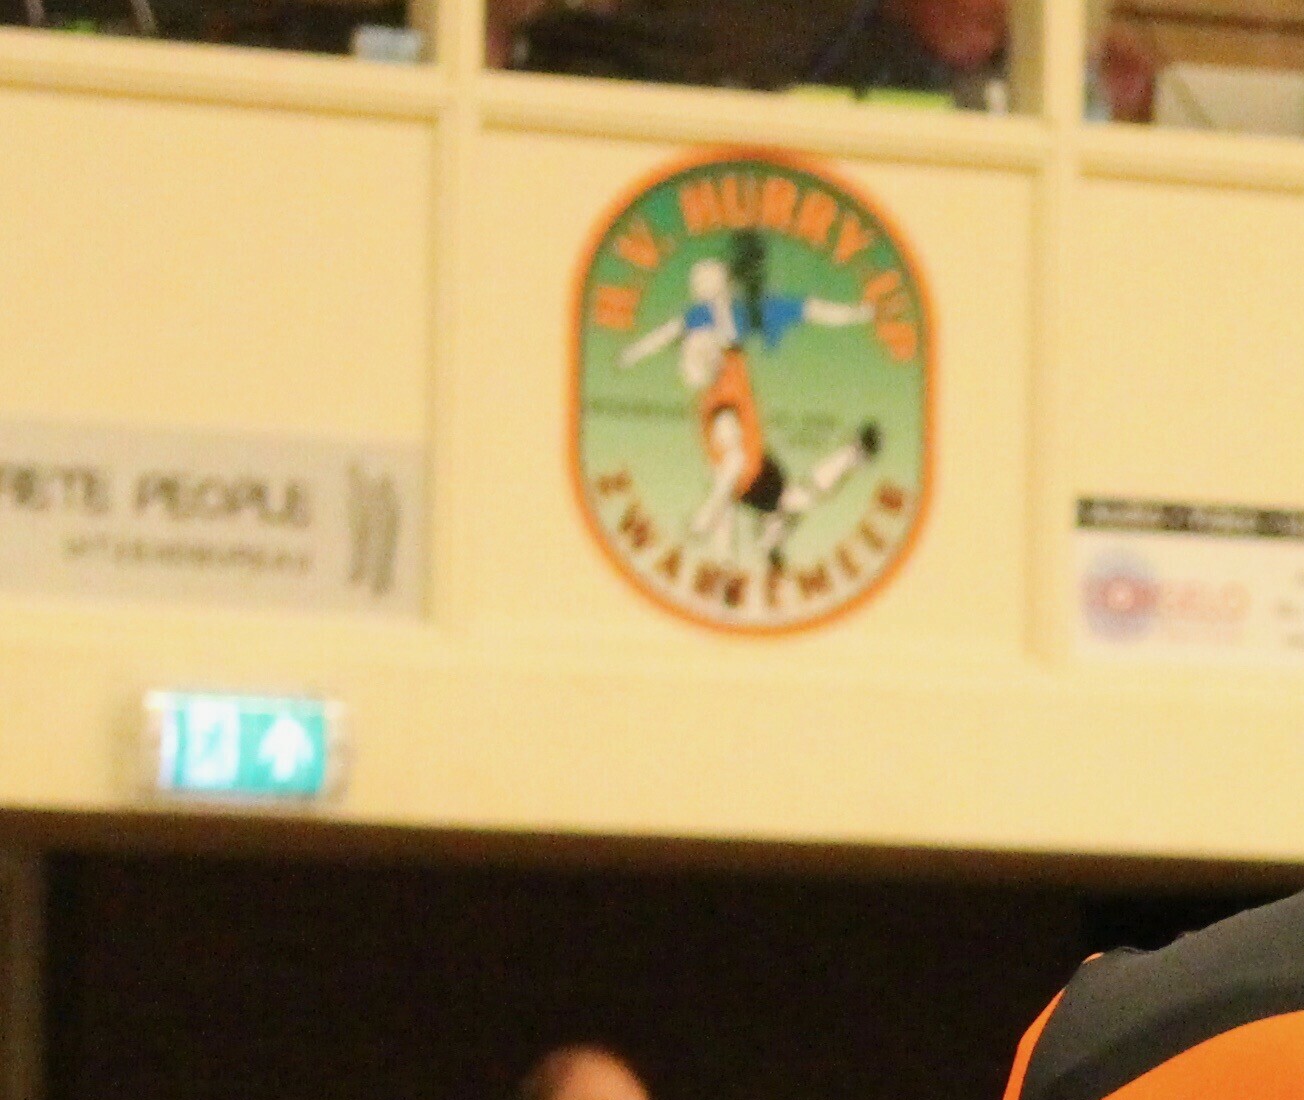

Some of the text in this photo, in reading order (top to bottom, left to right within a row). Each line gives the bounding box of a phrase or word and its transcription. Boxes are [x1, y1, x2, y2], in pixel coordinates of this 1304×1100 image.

[680, 174, 875, 267] HURRY
[862, 268, 919, 363] UP
[132, 468, 314, 532] PEOPLE
